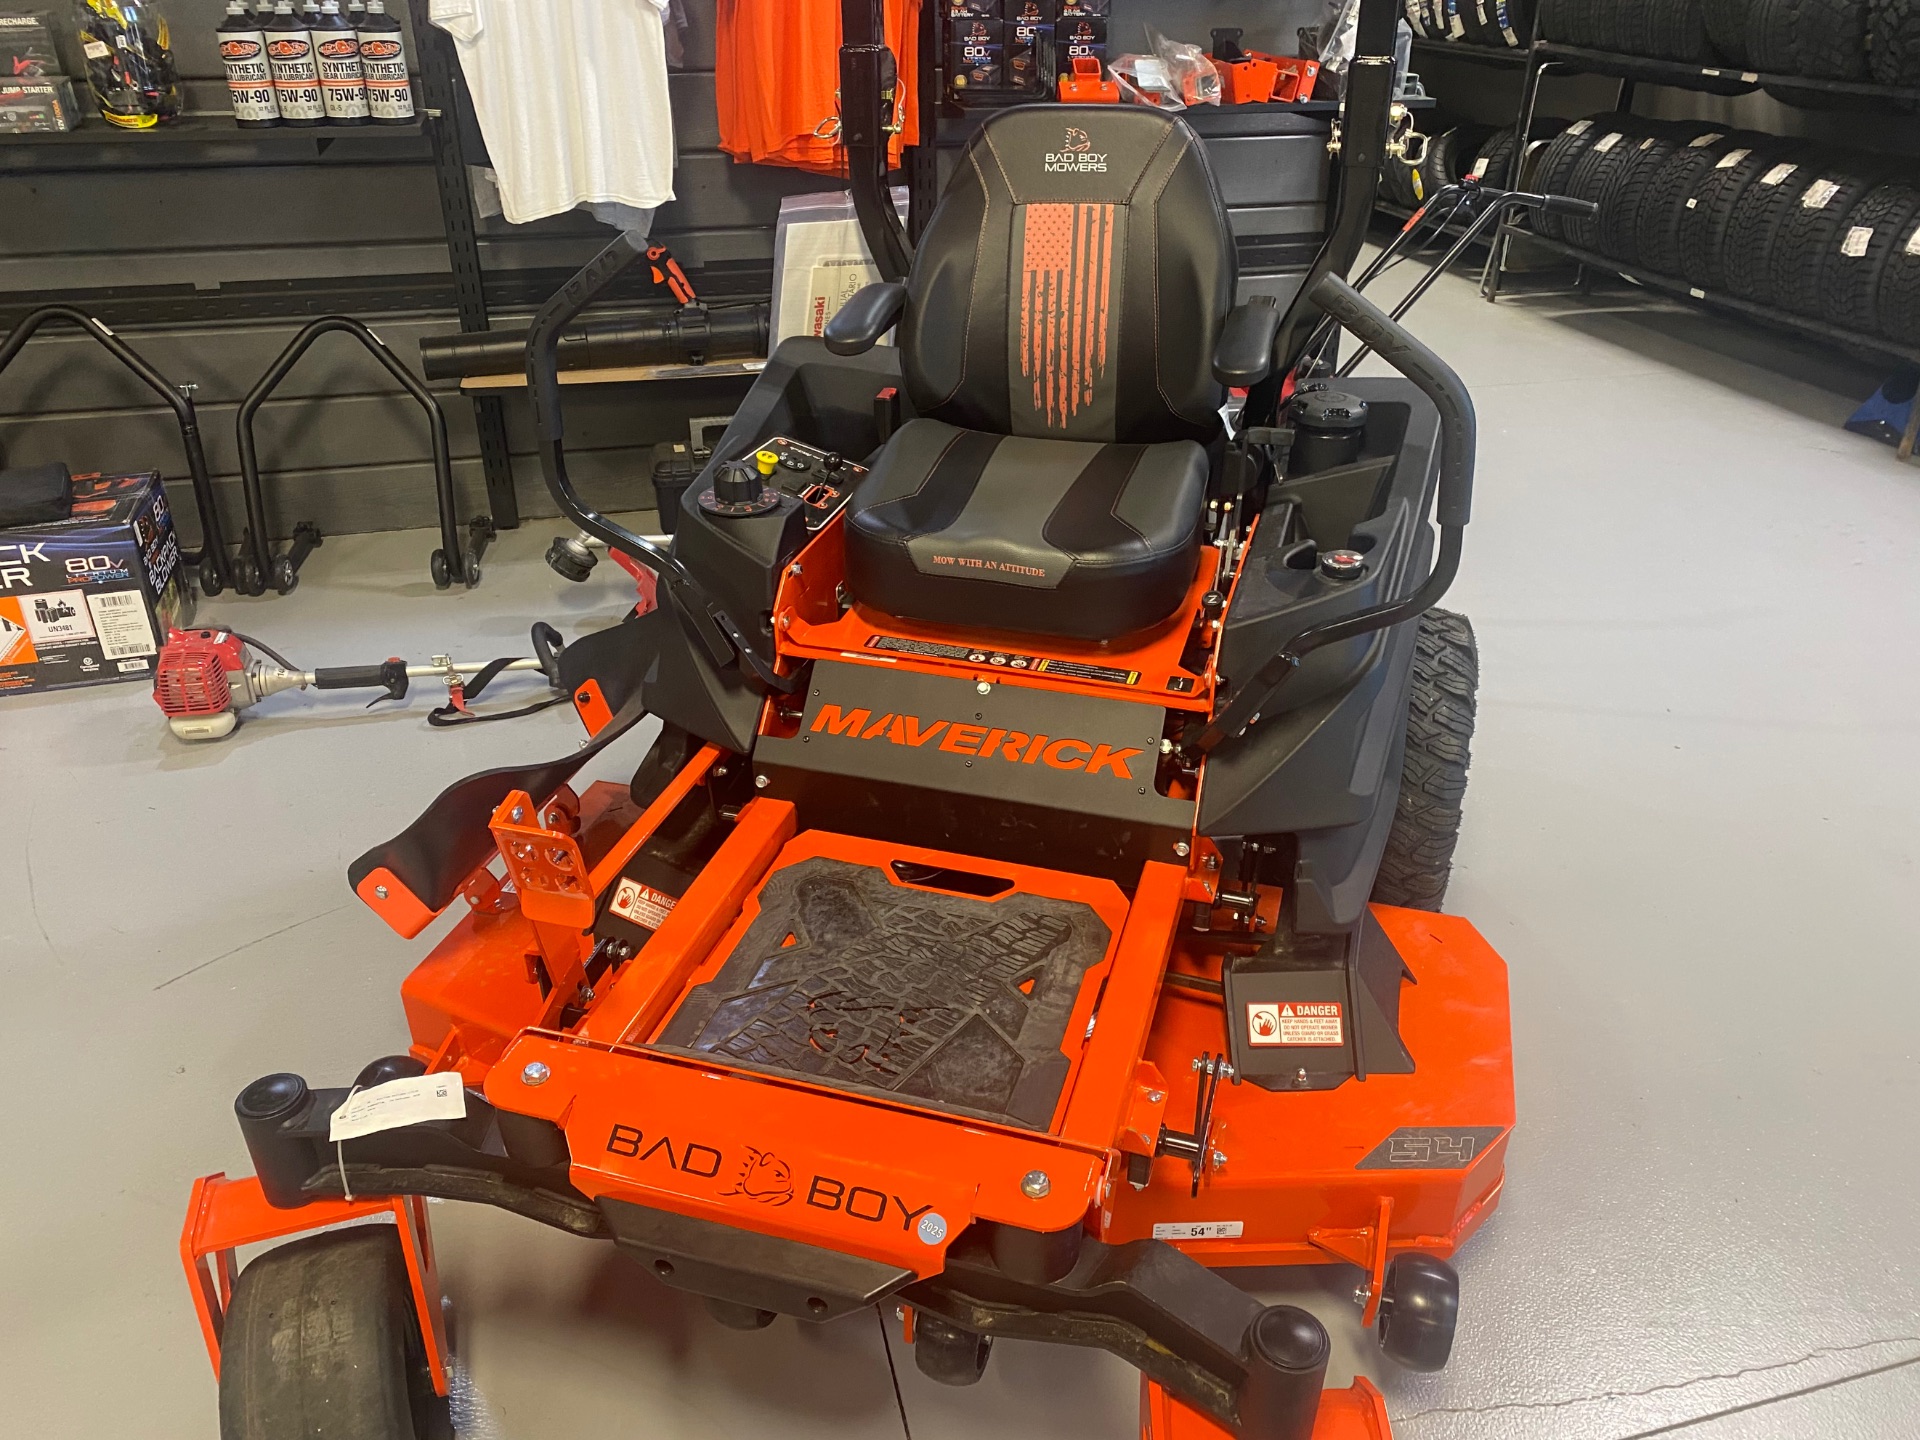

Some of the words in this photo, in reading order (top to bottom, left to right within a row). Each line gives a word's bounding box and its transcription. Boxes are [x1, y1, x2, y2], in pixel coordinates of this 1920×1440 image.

[1016, 26, 1036, 37] 80
[225, 62, 265, 74] YNTHETIC
[322, 61, 361, 73] SYNTHET
[234, 73, 267, 81] LUBRICANT
[284, 72, 315, 81] LUBRICANT
[2, 86, 21, 94] JUMP
[22, 86, 54, 94] STARTER
[1045, 153, 1075, 163] BAD
[1078, 153, 1108, 163] BOY
[1044, 163, 1108, 173] MOWERS
[813, 296, 825, 337] wasaki
[933, 555, 955, 565] MOW
[958, 557, 982, 568] WITH
[984, 560, 997, 570] AN
[999, 563, 1046, 577] ATTITUDE
[809, 703, 1145, 780] MAVERICK
[651, 892, 677, 910] DANGE
[1296, 1005, 1338, 1016] DANGER
[1388, 1136, 1475, 1162] 54
[605, 1123, 723, 1179] BAD
[806, 1175, 935, 1232] BOY
[920, 1219, 944, 1239] 2025
[1191, 1227, 1212, 1237] 54"
